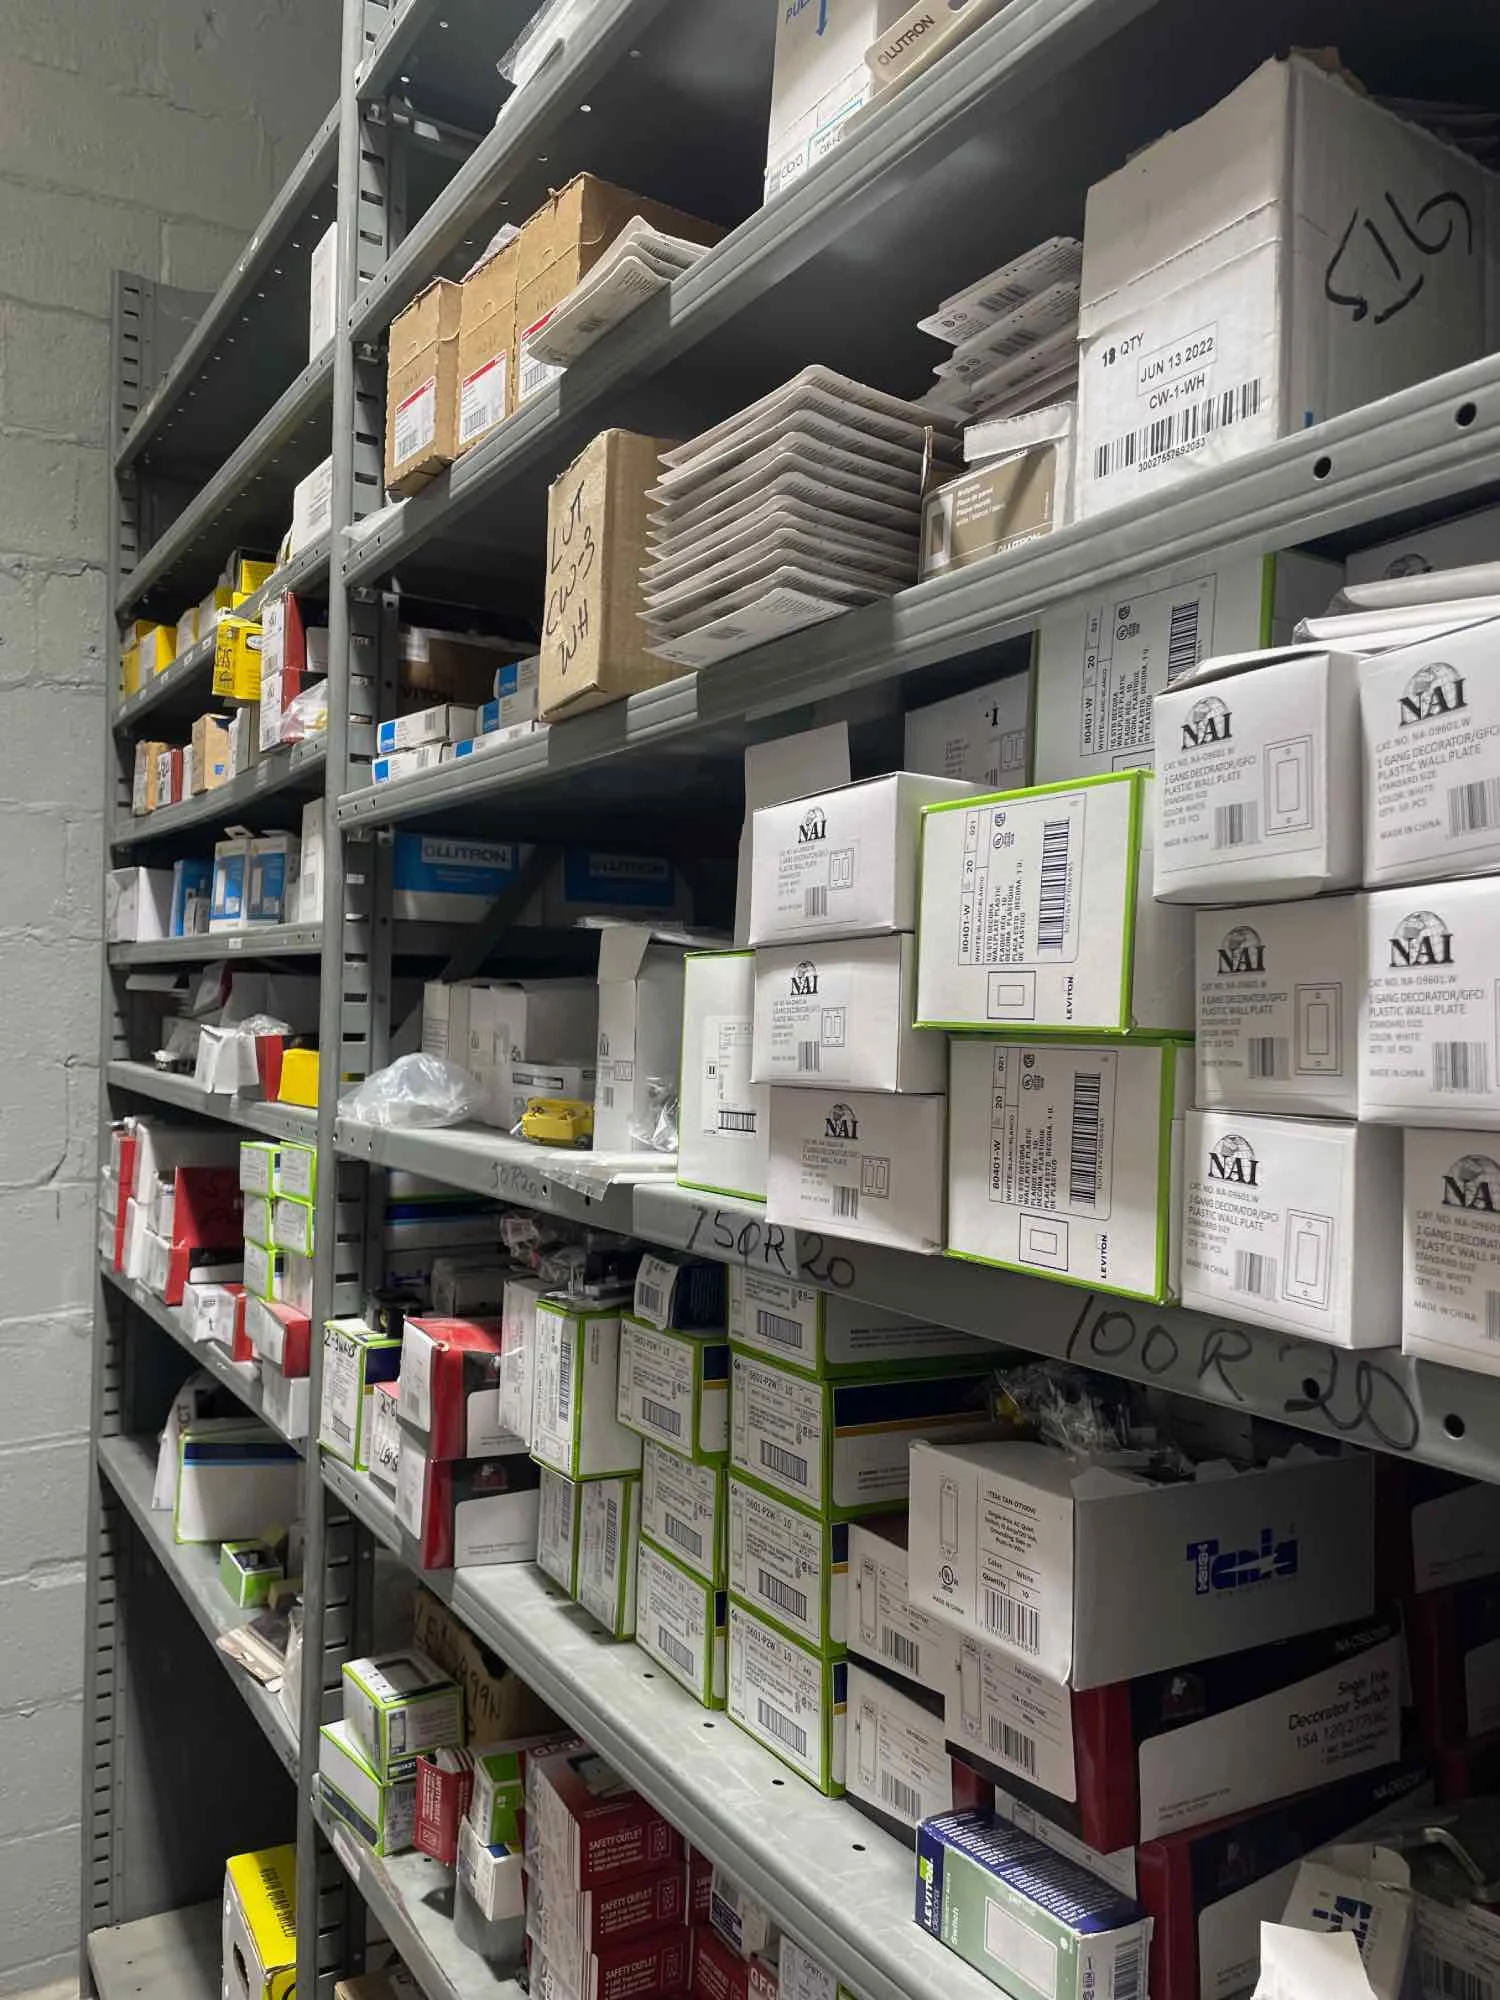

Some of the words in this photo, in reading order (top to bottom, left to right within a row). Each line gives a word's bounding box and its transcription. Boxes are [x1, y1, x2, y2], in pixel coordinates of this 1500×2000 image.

[1120, 333, 1144, 356] QTY
[1140, 359, 1164, 383] JUN
[1168, 352, 1183, 369] 13
[1185, 337, 1214, 363] 2022
[1149, 373, 1206, 409] CW-1-WH
[559, 598, 589, 675] WH
[401, 684, 455, 702] VITON
[1398, 678, 1468, 727] NAI
[1181, 712, 1233, 750] NAI
[1377, 759, 1416, 781] PLASTIC
[1418, 751, 1446, 771] WALL
[1448, 742, 1481, 764] PLATE
[1384, 748, 1411, 767] GANG
[1216, 770, 1240, 785] PLATE
[798, 820, 827, 844] NAI
[966, 859, 973, 873] 20
[1217, 946, 1266, 976] NAI
[1389, 934, 1455, 968] NAI
[790, 976, 818, 996] NAI
[1064, 976, 1074, 1020] LEVITON
[1369, 1005, 1403, 1016] PLASTIC
[1405, 1005, 1432, 1016] WALL
[1434, 1004, 1466, 1015] PLATE
[824, 1118, 859, 1140] NAI
[992, 1139, 1000, 1189] 80401-W
[1208, 1152, 1260, 1187] NAI
[1442, 1175, 1500, 1213] NA
[1218, 1211, 1238, 1226] WALL
[1239, 1216, 1264, 1232] PLATE
[1416, 1237, 1456, 1256] PLASTIC
[1459, 1245, 1488, 1263] WALL
[1454, 1231, 1500, 1251] DECORAT
[801, 1232, 855, 1288] 20
[1066, 1294, 1252, 1402] 100R
[982, 1570, 1006, 1590] Quantity
[1016, 1568, 1033, 1584] White
[1288, 1696, 1349, 1732] Decorator
[1296, 1729, 1317, 1750] 15A
[589, 1835, 614, 1850] SAFETY
[606, 1964, 631, 1980] SAFETY
